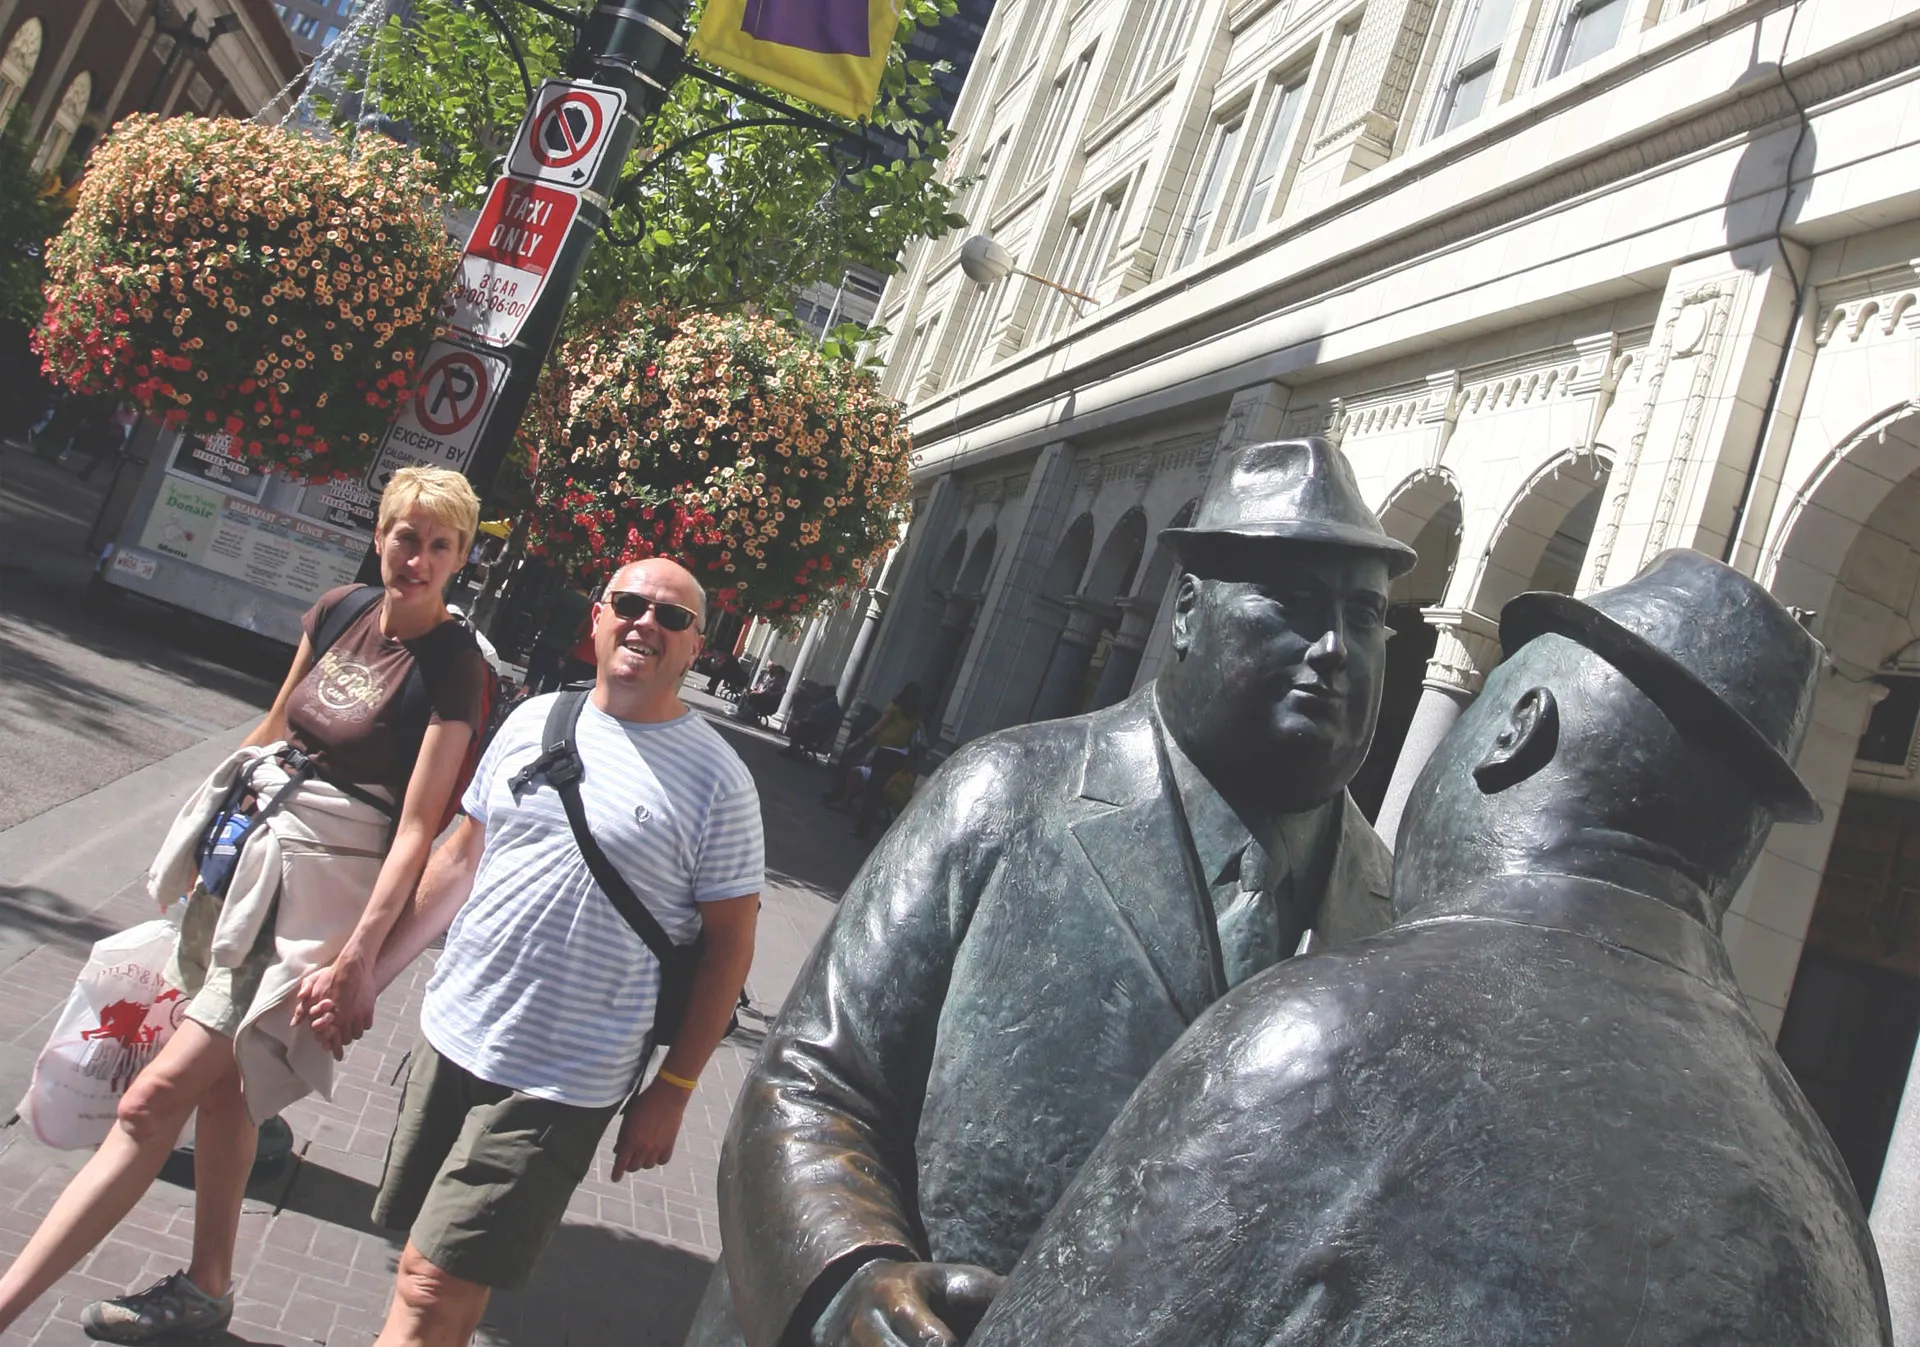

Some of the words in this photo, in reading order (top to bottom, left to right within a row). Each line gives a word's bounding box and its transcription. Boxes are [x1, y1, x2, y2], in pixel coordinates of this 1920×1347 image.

[505, 193, 554, 227] TAXI
[488, 223, 543, 258] ONLY
[479, 273, 490, 289] 3
[491, 278, 519, 298] CAR
[384, 446, 417, 465] CALGARY
[392, 426, 444, 455] EXCEPT
[445, 446, 466, 464] BY
[164, 495, 214, 519] Donair
[229, 500, 278, 524] BREAKFAST
[295, 519, 324, 539] LUNCH
[156, 543, 188, 559] Menu
[318, 651, 358, 686] Hard
[344, 676, 385, 710] Rock
